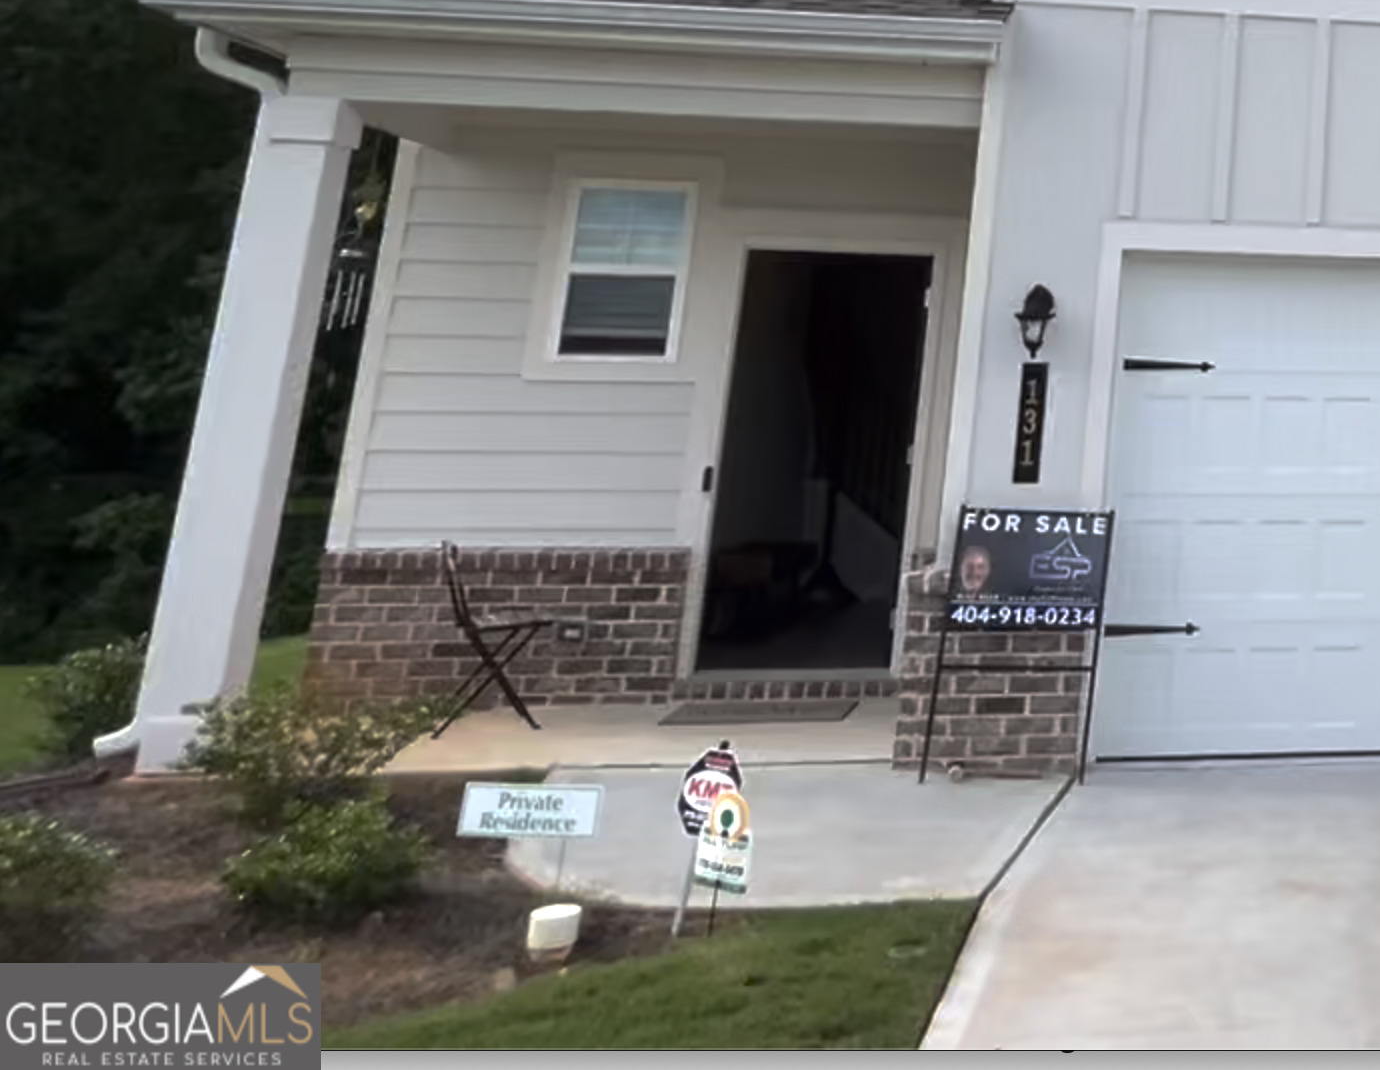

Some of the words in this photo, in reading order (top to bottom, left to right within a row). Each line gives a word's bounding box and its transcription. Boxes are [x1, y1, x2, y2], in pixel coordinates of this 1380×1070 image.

[1020, 378, 1039, 467] 131
[963, 513, 1021, 532] FOR
[1035, 515, 1108, 535] SALE
[951, 605, 1096, 625] 404-918-0234
[498, 791, 564, 811] Private
[479, 811, 577, 832] Residence
